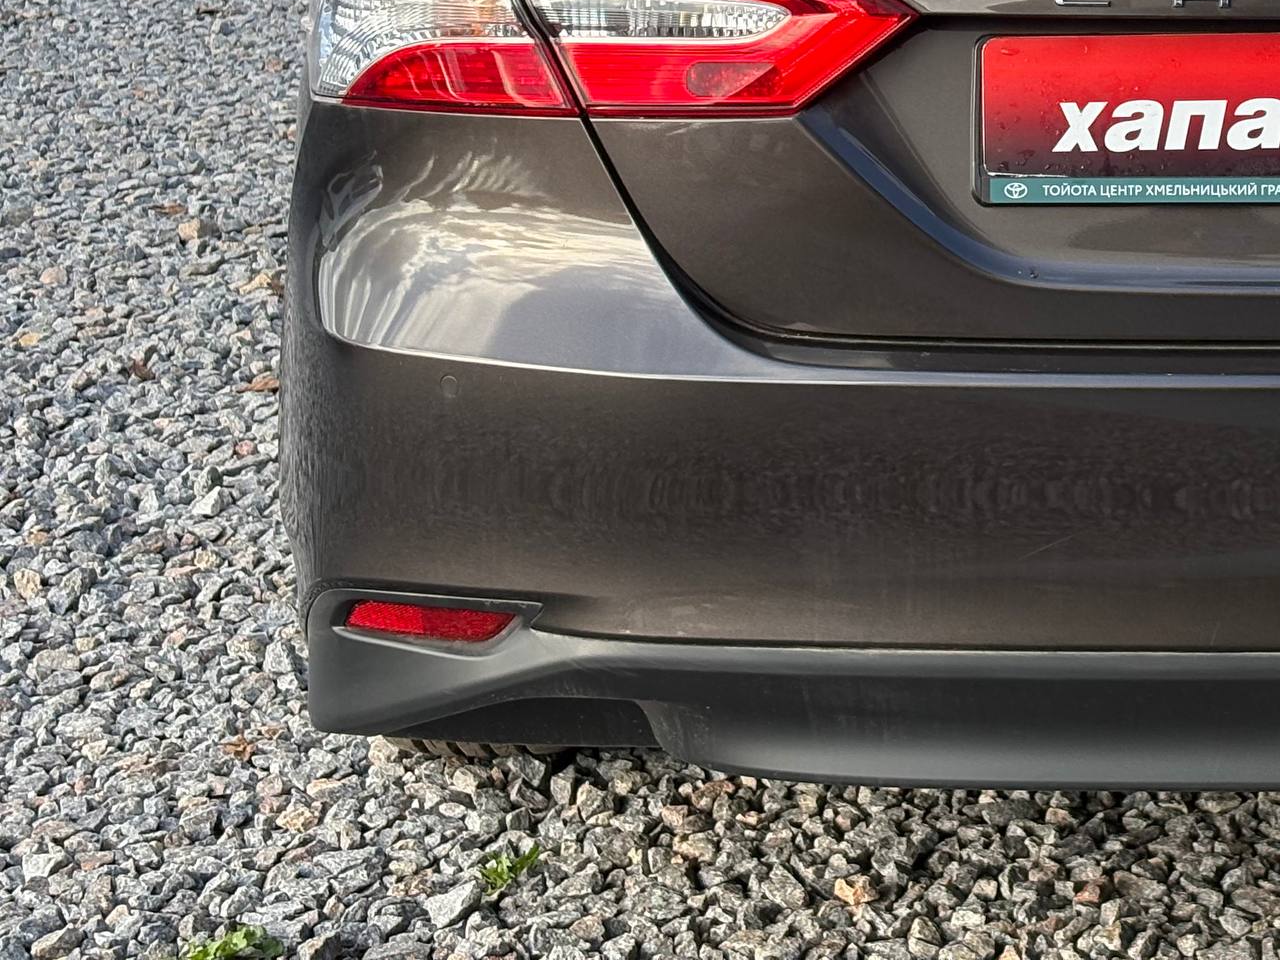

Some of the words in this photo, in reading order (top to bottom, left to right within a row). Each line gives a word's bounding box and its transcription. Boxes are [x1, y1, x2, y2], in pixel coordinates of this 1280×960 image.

[1042, 183, 1097, 197] ТОЙОТА
[1100, 184, 1143, 198] ЦЕНТР
[1145, 182, 1257, 198] ХМЕЛЬНИЦЬКИЙ
